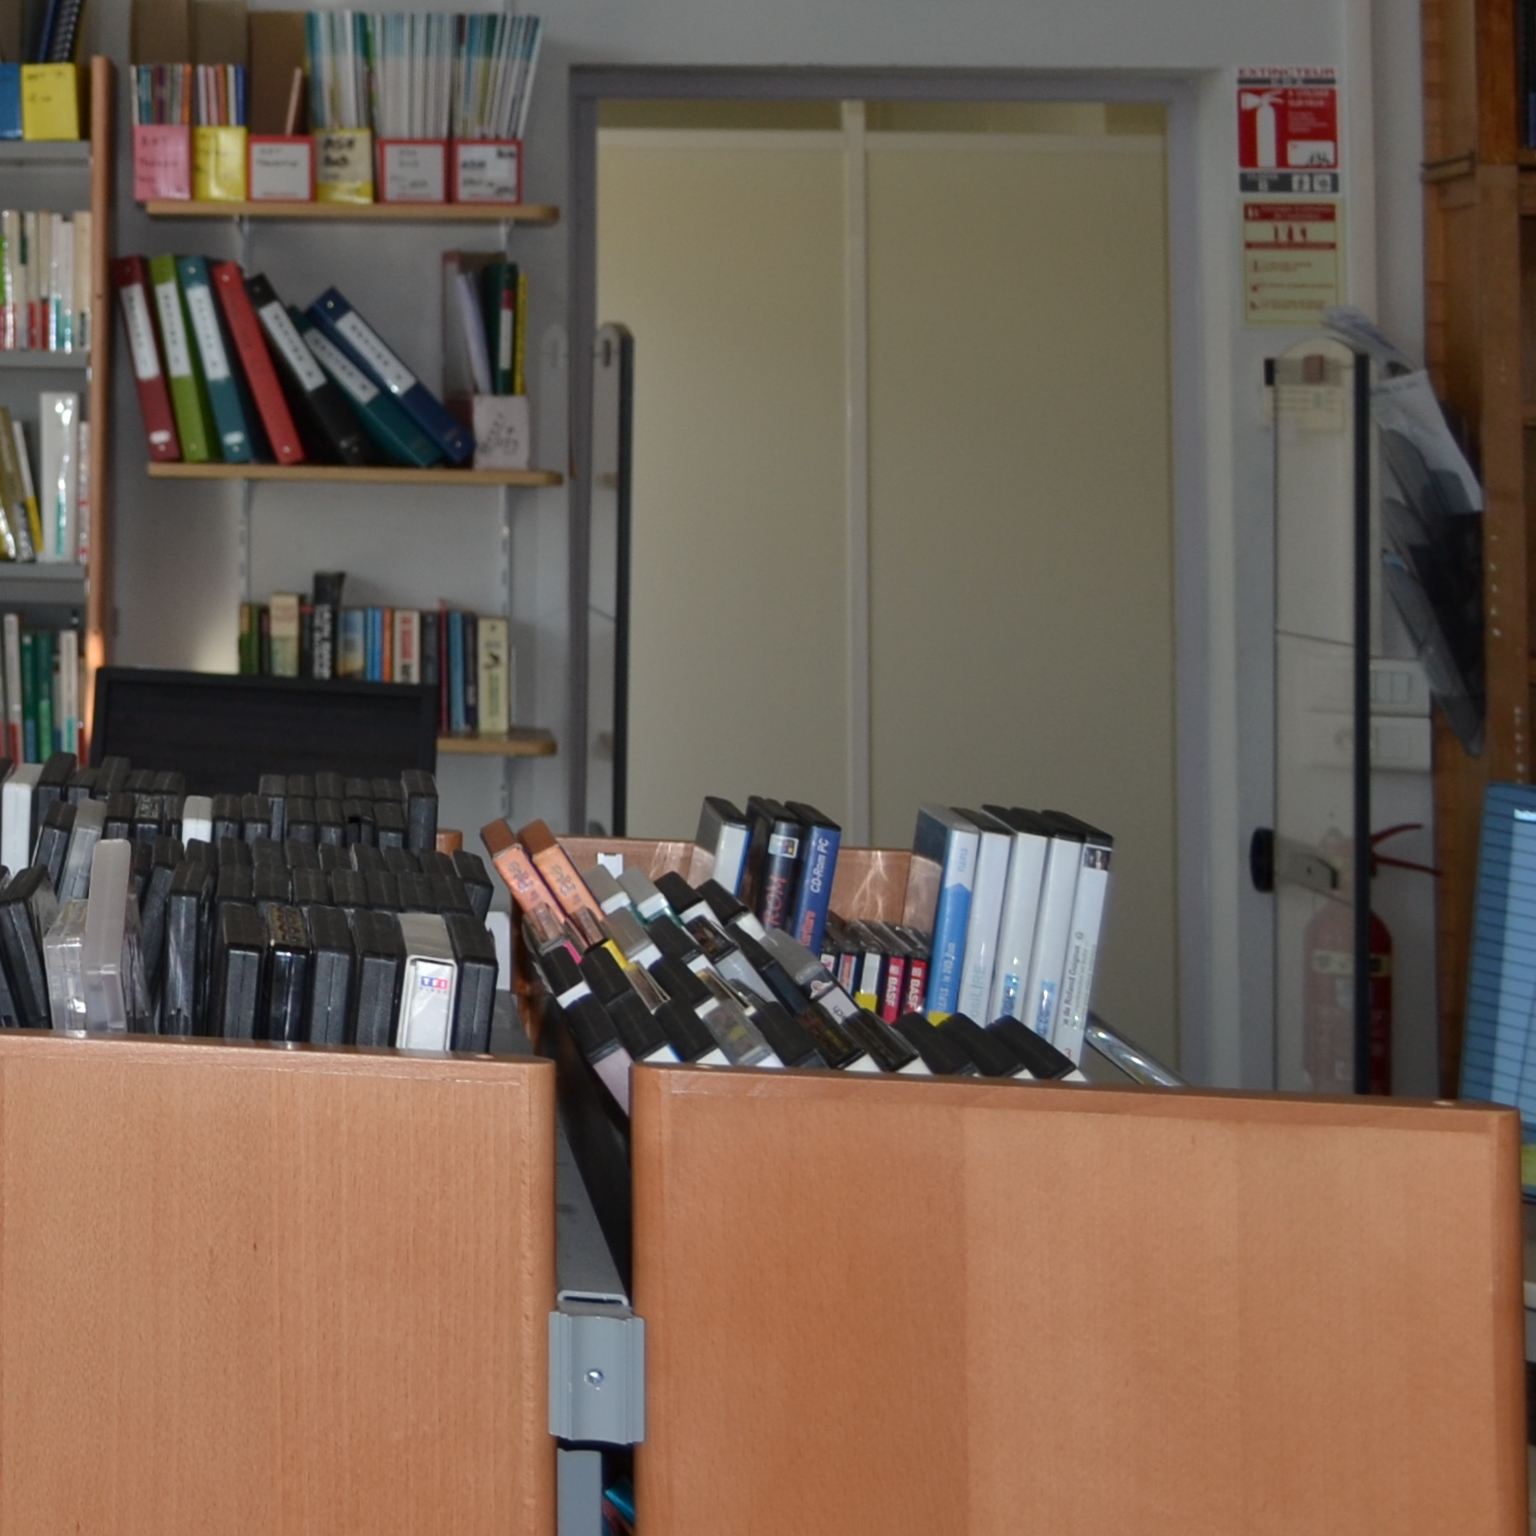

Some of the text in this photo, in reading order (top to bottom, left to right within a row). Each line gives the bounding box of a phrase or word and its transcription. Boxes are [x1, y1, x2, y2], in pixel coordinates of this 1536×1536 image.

[810, 837, 829, 893] CD-Rom PC
[885, 977, 897, 1007] BASF
[908, 979, 921, 1008] BASF
